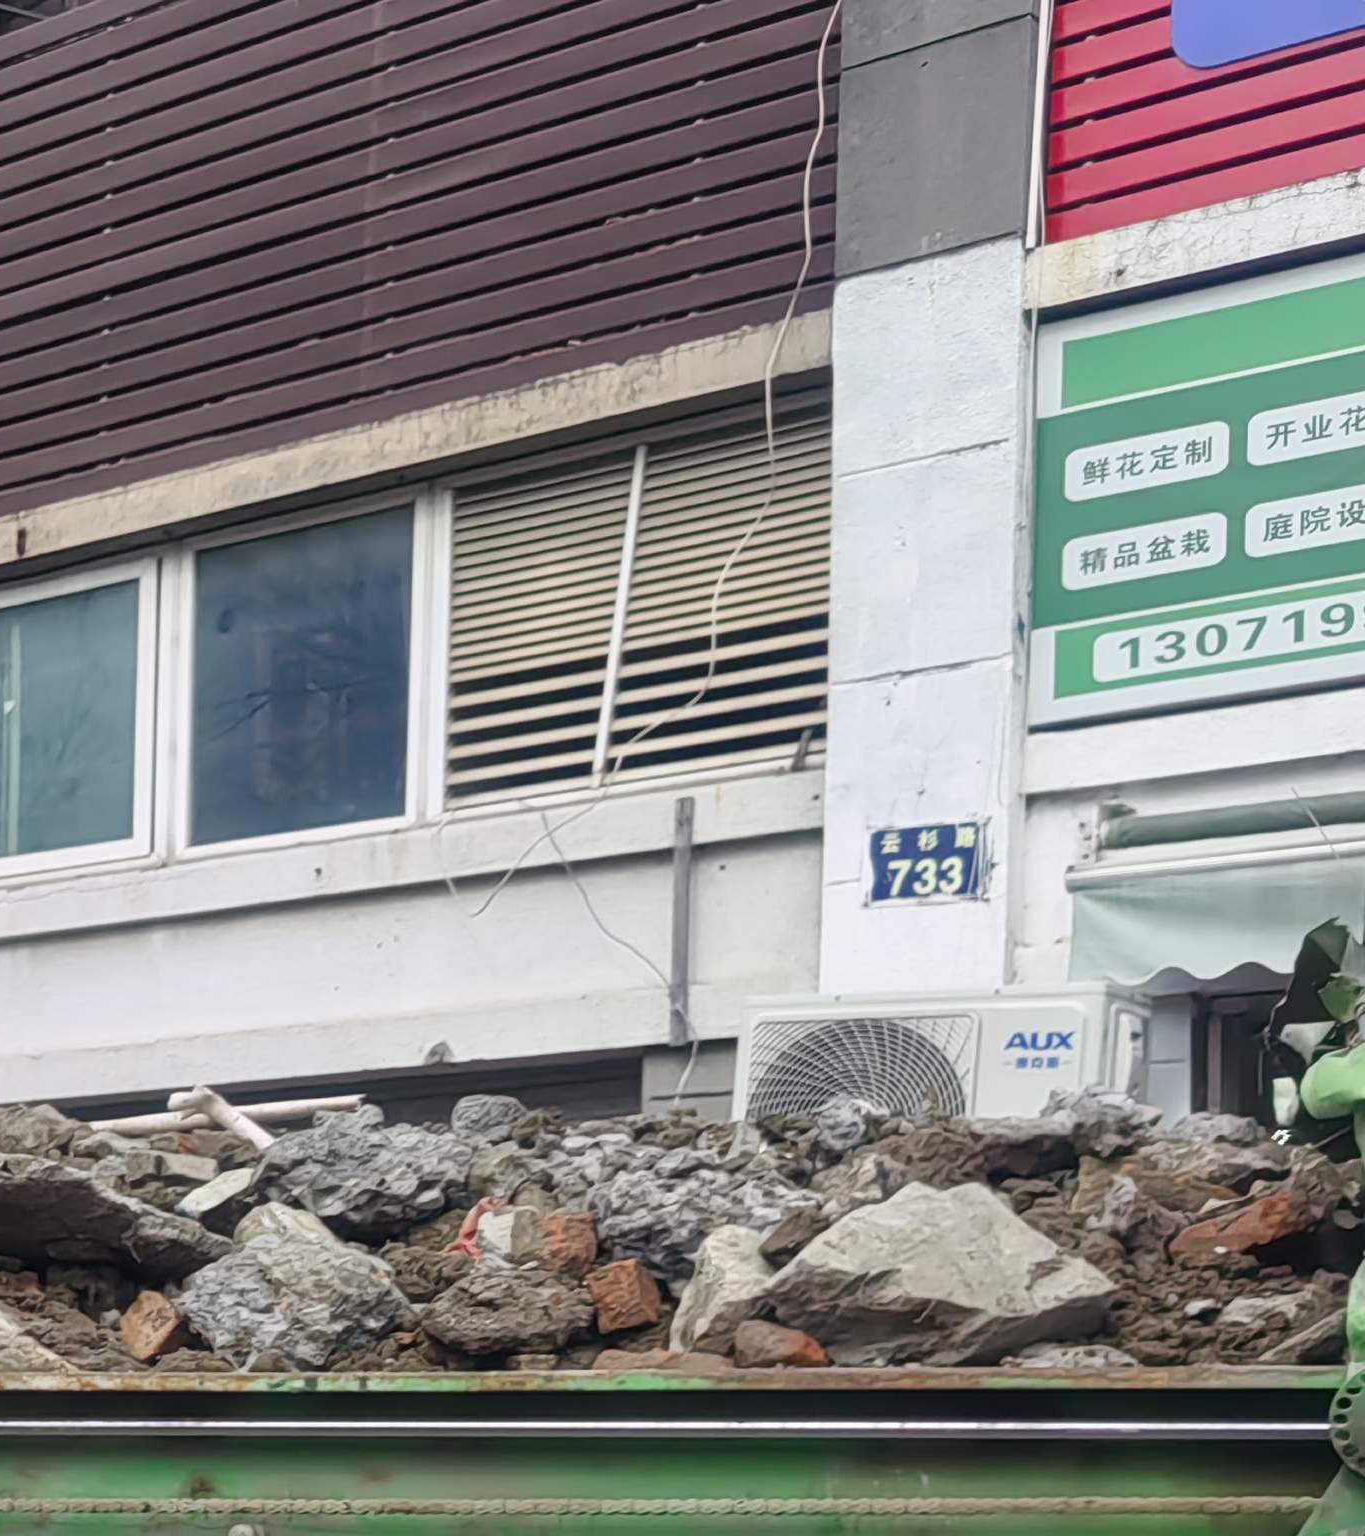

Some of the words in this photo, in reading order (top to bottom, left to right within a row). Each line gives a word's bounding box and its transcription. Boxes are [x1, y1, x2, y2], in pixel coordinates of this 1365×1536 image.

[1082, 436, 1213, 486] 鲜花定制
[1263, 499, 1365, 543] 庭院设
[1079, 529, 1211, 576] 精品盆栽
[1119, 602, 1365, 669] 130719
[888, 856, 963, 897] 733
[1004, 1031, 1075, 1051] AUX
